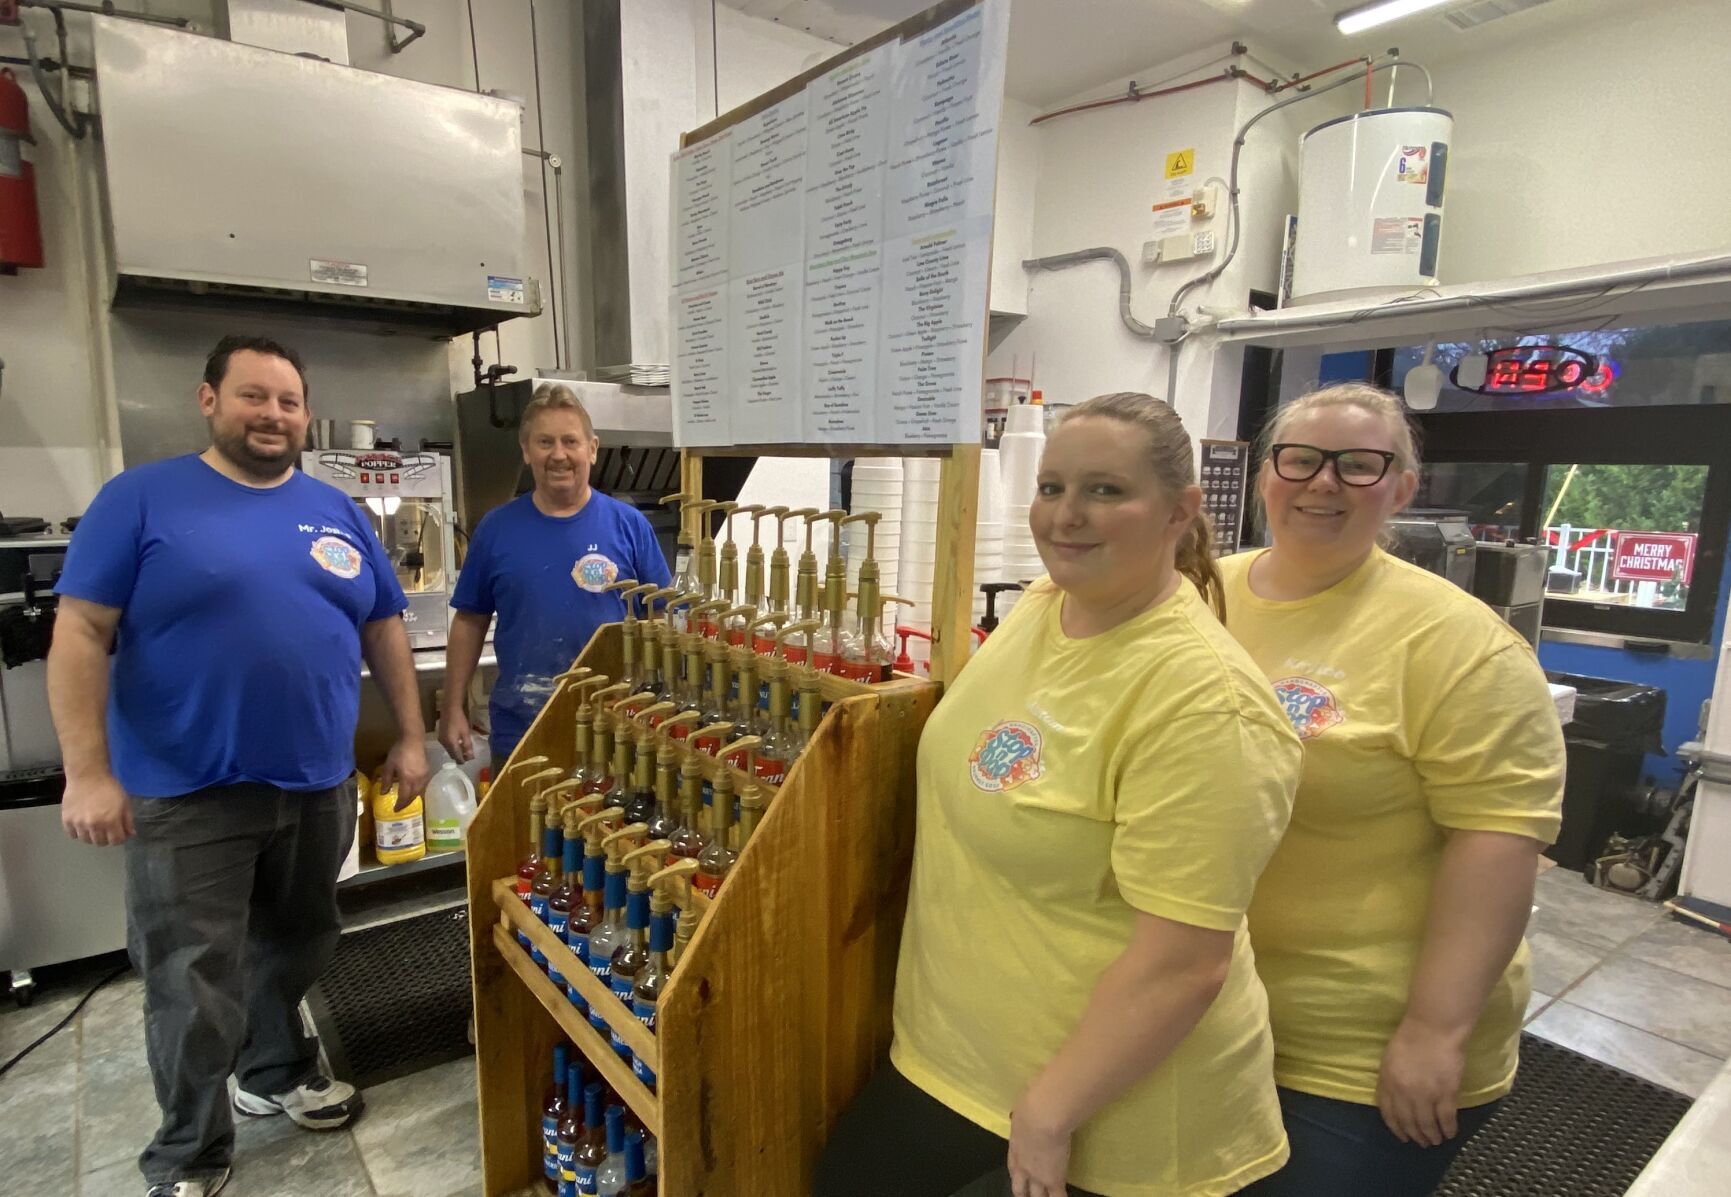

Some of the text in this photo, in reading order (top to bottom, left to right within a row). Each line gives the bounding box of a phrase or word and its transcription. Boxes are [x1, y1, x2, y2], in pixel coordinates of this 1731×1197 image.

[1399, 157, 1406, 174] 6
[361, 460, 397, 468] POPPER
[298, 524, 318, 532] Mr.
[588, 544, 598, 552] JJ
[1634, 543, 1672, 556] MERRY
[1620, 555, 1684, 571] CHRISTMAS
